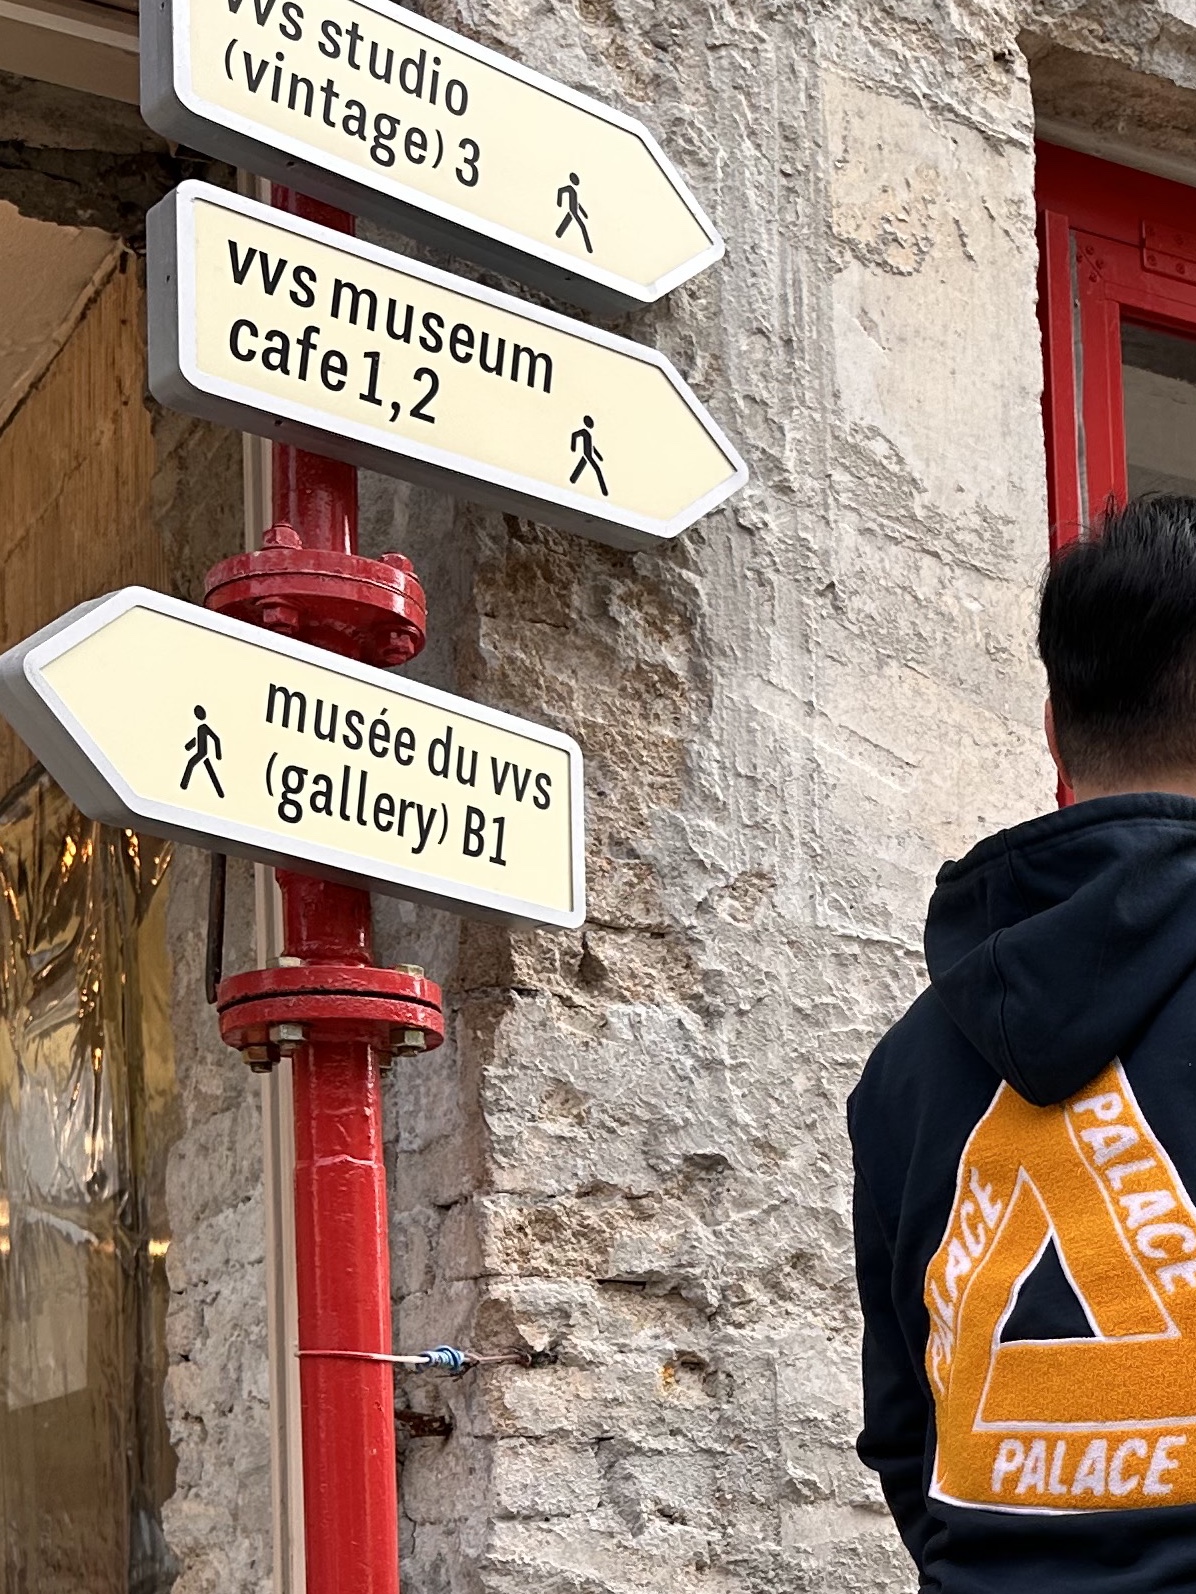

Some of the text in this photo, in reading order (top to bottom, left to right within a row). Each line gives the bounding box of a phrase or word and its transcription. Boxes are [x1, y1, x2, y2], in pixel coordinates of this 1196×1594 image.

[224, 38, 481, 188] (vintage) 3
[318, 20, 469, 117] studio
[227, 240, 554, 394] vvs museum
[229, 319, 440, 424] cafe 1,2
[265, 683, 551, 810] musée du vvs
[265, 751, 508, 866] (gallery) B1
[992, 1435, 1189, 1497] PALACE
